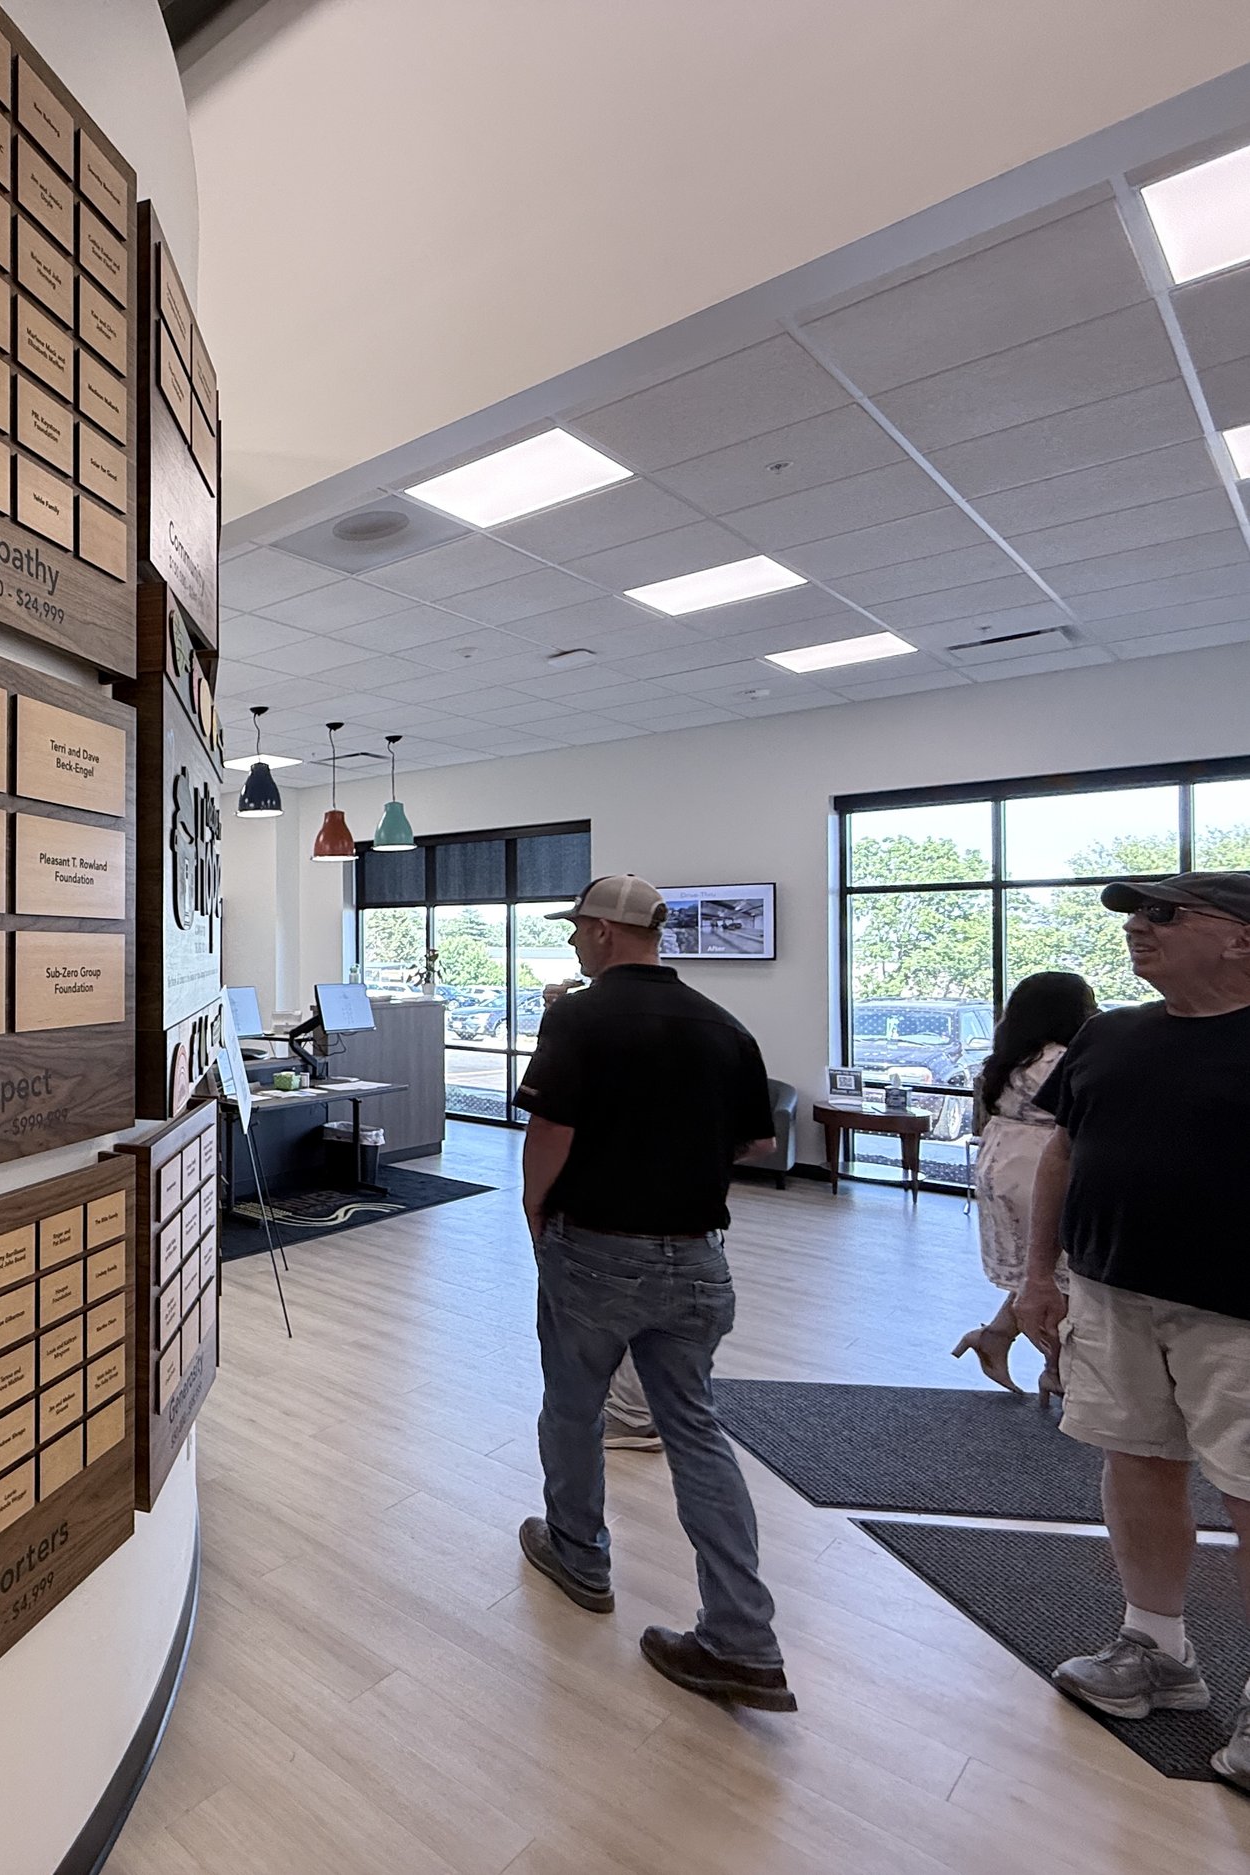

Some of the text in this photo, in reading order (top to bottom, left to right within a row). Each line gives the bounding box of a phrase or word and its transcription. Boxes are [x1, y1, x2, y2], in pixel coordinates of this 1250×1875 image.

[38, 183, 48, 195] and
[29, 250, 62, 285] Brian and Julie
[26, 327, 45, 347] Marlene
[57, 354, 66, 365] and
[27, 337, 48, 359] Elizabeth
[87, 383, 104, 401] Madison
[33, 420, 59, 443] Foundation
[40, 416, 61, 436] Keystone
[45, 500, 60, 516] Family
[169, 520, 205, 596] Community
[16, 588, 65, 624] $24,999
[49, 738, 100, 764] Terri and Dave
[55, 757, 94, 778] Beck-Engel
[39, 852, 108, 872] Pleasant T. Rowland
[54, 870, 94, 885] Foundation
[45, 966, 101, 979] Sub-Zero Group
[54, 982, 94, 994] Foundation
[13, 1108, 69, 1136] $999,999
[63, 1227, 71, 1235] and
[3, 1259, 14, 1268] John
[51, 1290, 72, 1304] Foundation
[56, 1341, 64, 1351] and
[13, 1365, 22, 1376] and
[169, 1352, 204, 1424] Generosity
[54, 1399, 63, 1408] and
[12, 1571, 55, 1621] $4,999
